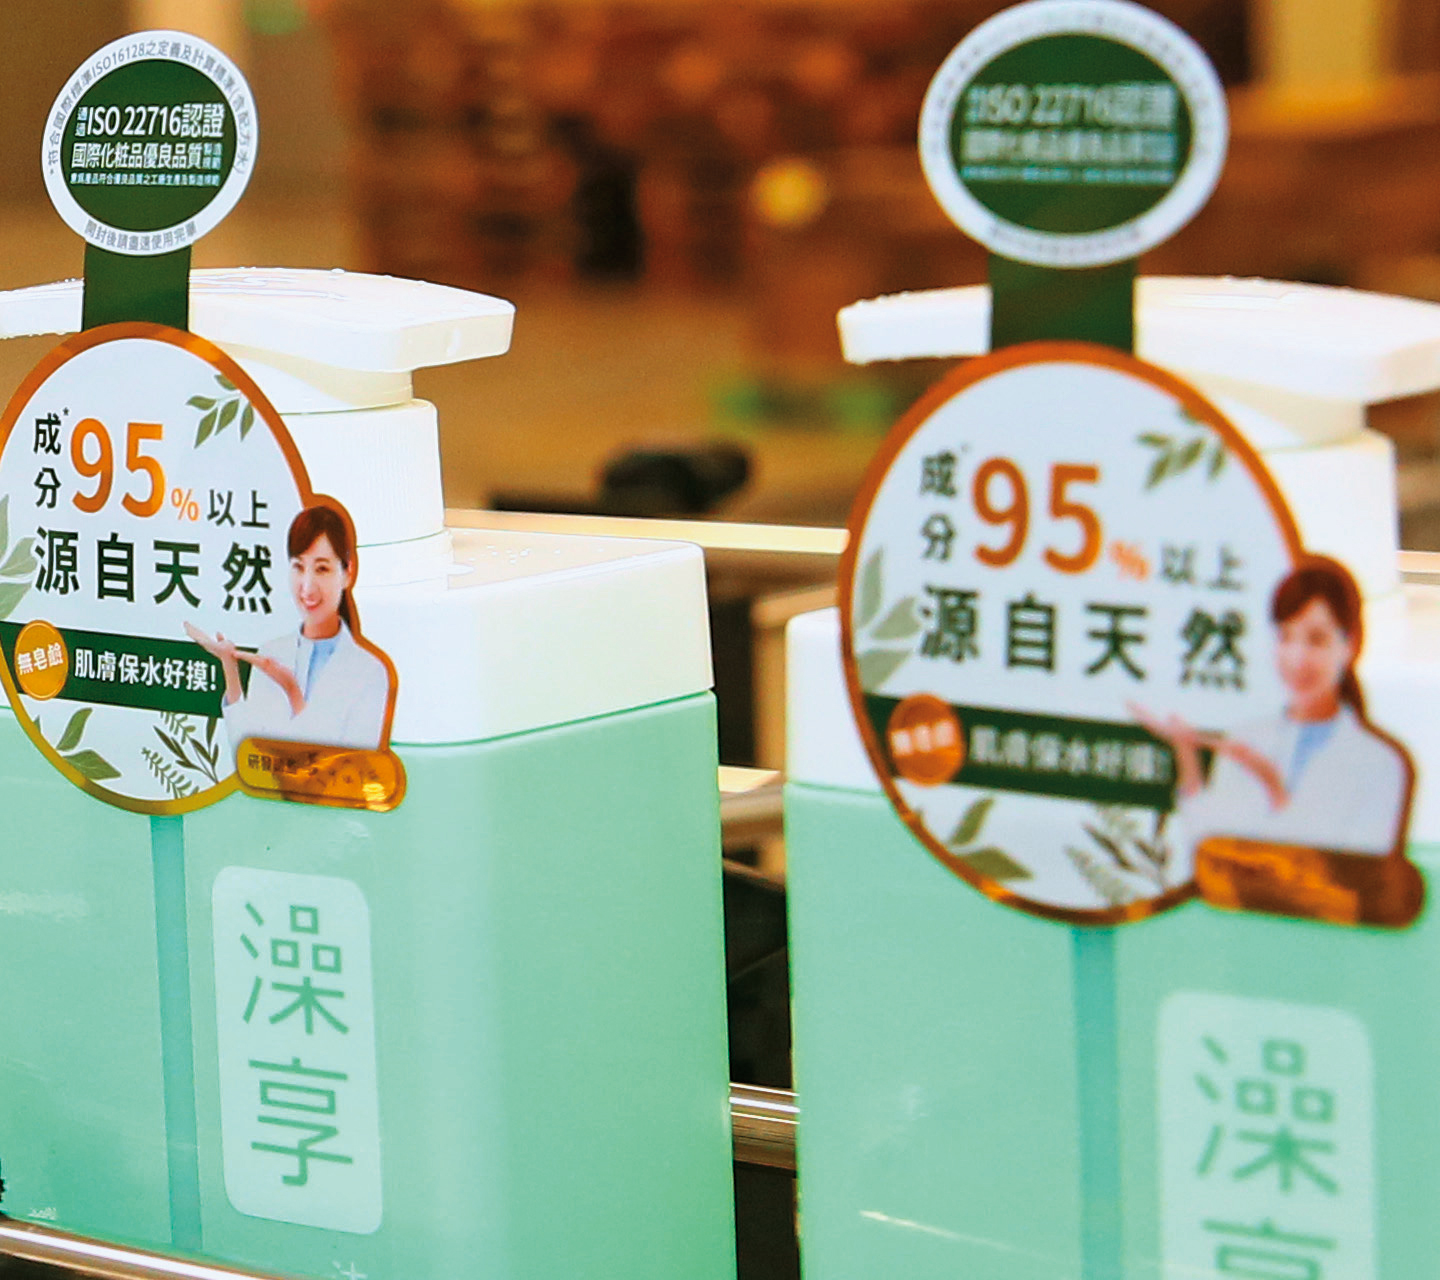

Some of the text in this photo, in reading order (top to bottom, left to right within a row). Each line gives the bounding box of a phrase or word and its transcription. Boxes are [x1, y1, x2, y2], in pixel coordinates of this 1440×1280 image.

[87, 106, 120, 135] ISO
[35, 526, 272, 614] 源自天然
[75, 648, 216, 692] 肌膚保水好摸!
[921, 585, 1246, 691] 源自天然
[239, 900, 354, 1188] 澡享
